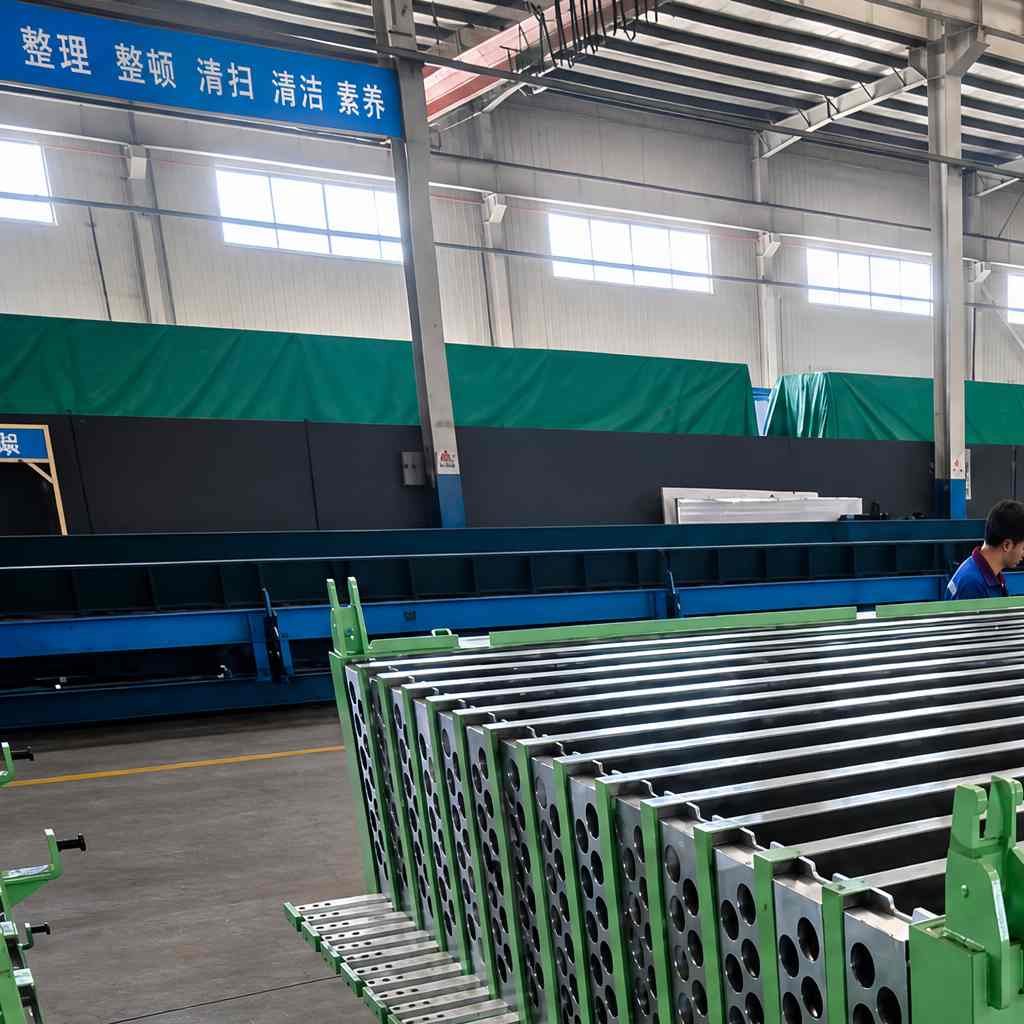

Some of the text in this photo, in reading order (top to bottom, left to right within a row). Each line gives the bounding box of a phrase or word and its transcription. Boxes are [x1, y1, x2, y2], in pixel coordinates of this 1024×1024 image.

[20, 27, 385, 120] 整理 整顿 清扫 清洁 素养
